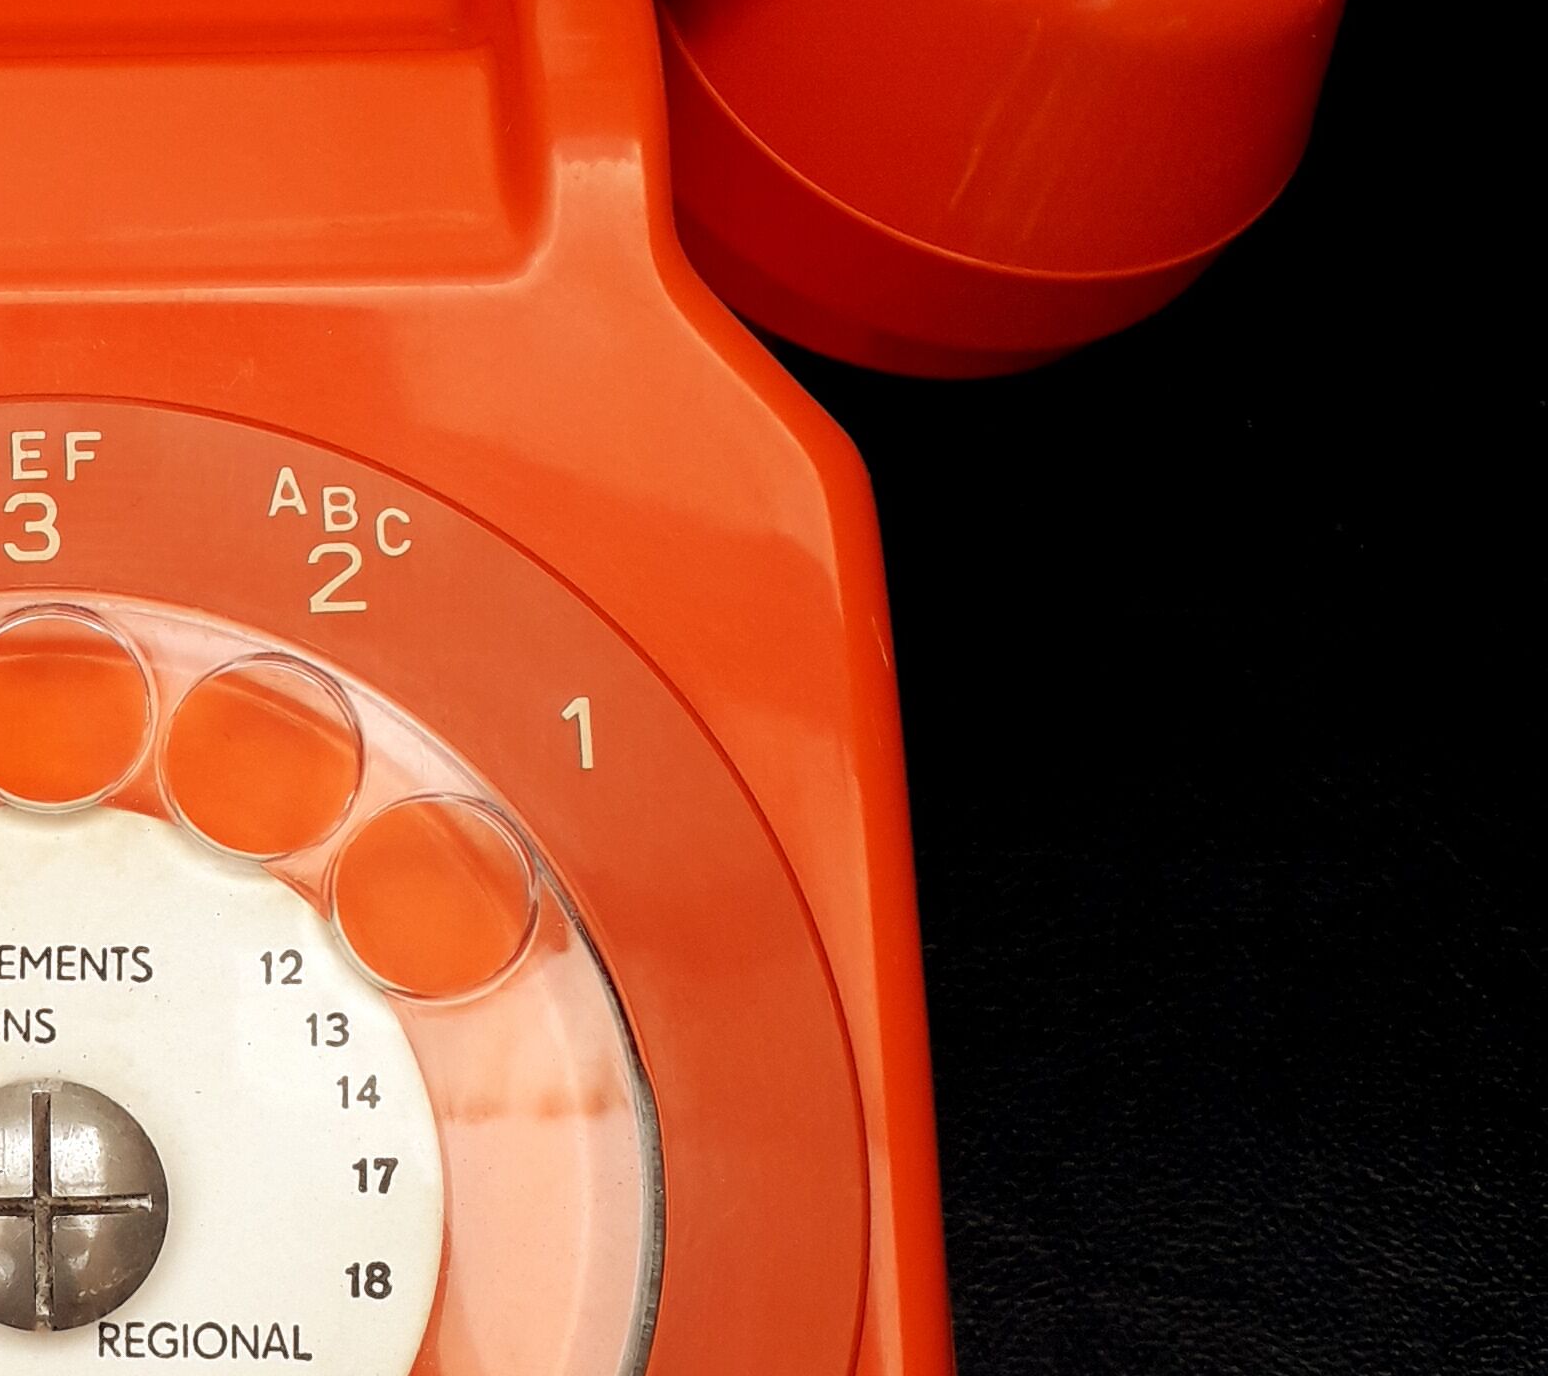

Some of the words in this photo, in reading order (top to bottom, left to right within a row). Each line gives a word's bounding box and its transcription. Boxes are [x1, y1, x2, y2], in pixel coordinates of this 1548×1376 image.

[2, 491, 62, 563] 3
[306, 541, 368, 614] 2
[560, 695, 595, 770] 1
[259, 948, 304, 987] 12
[305, 1010, 352, 1049] 13
[336, 1073, 382, 1111] 14
[351, 1156, 400, 1196] 17
[344, 1260, 394, 1301] 18
[98, 1320, 314, 1363] REGIONAL
